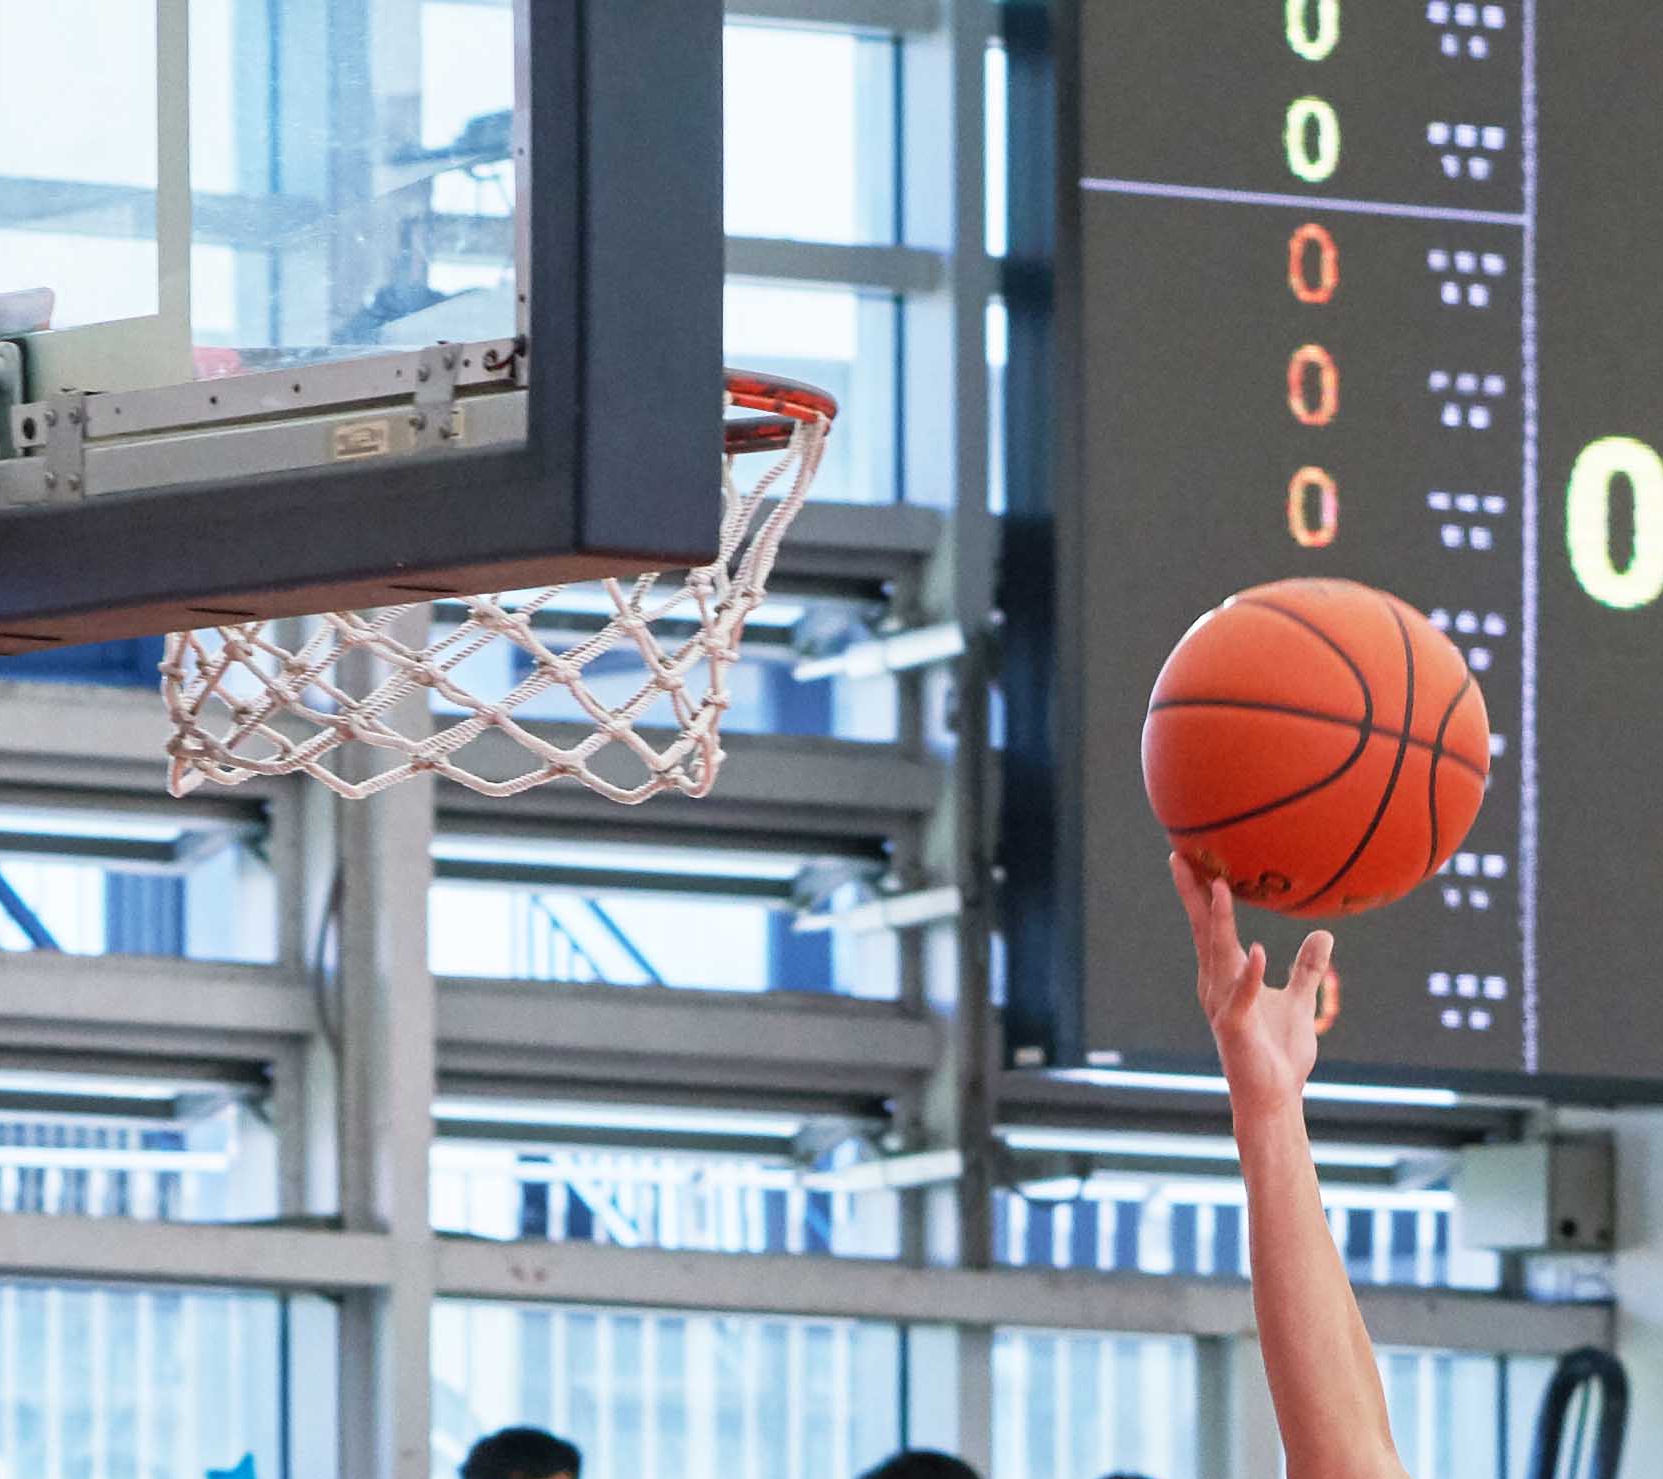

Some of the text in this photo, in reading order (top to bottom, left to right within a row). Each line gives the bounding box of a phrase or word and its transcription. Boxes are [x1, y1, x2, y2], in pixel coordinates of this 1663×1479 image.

[1283, 96, 1340, 182] 0
[1289, 223, 1339, 303] 0
[1288, 344, 1338, 425] 0
[1287, 467, 1338, 547] 0
